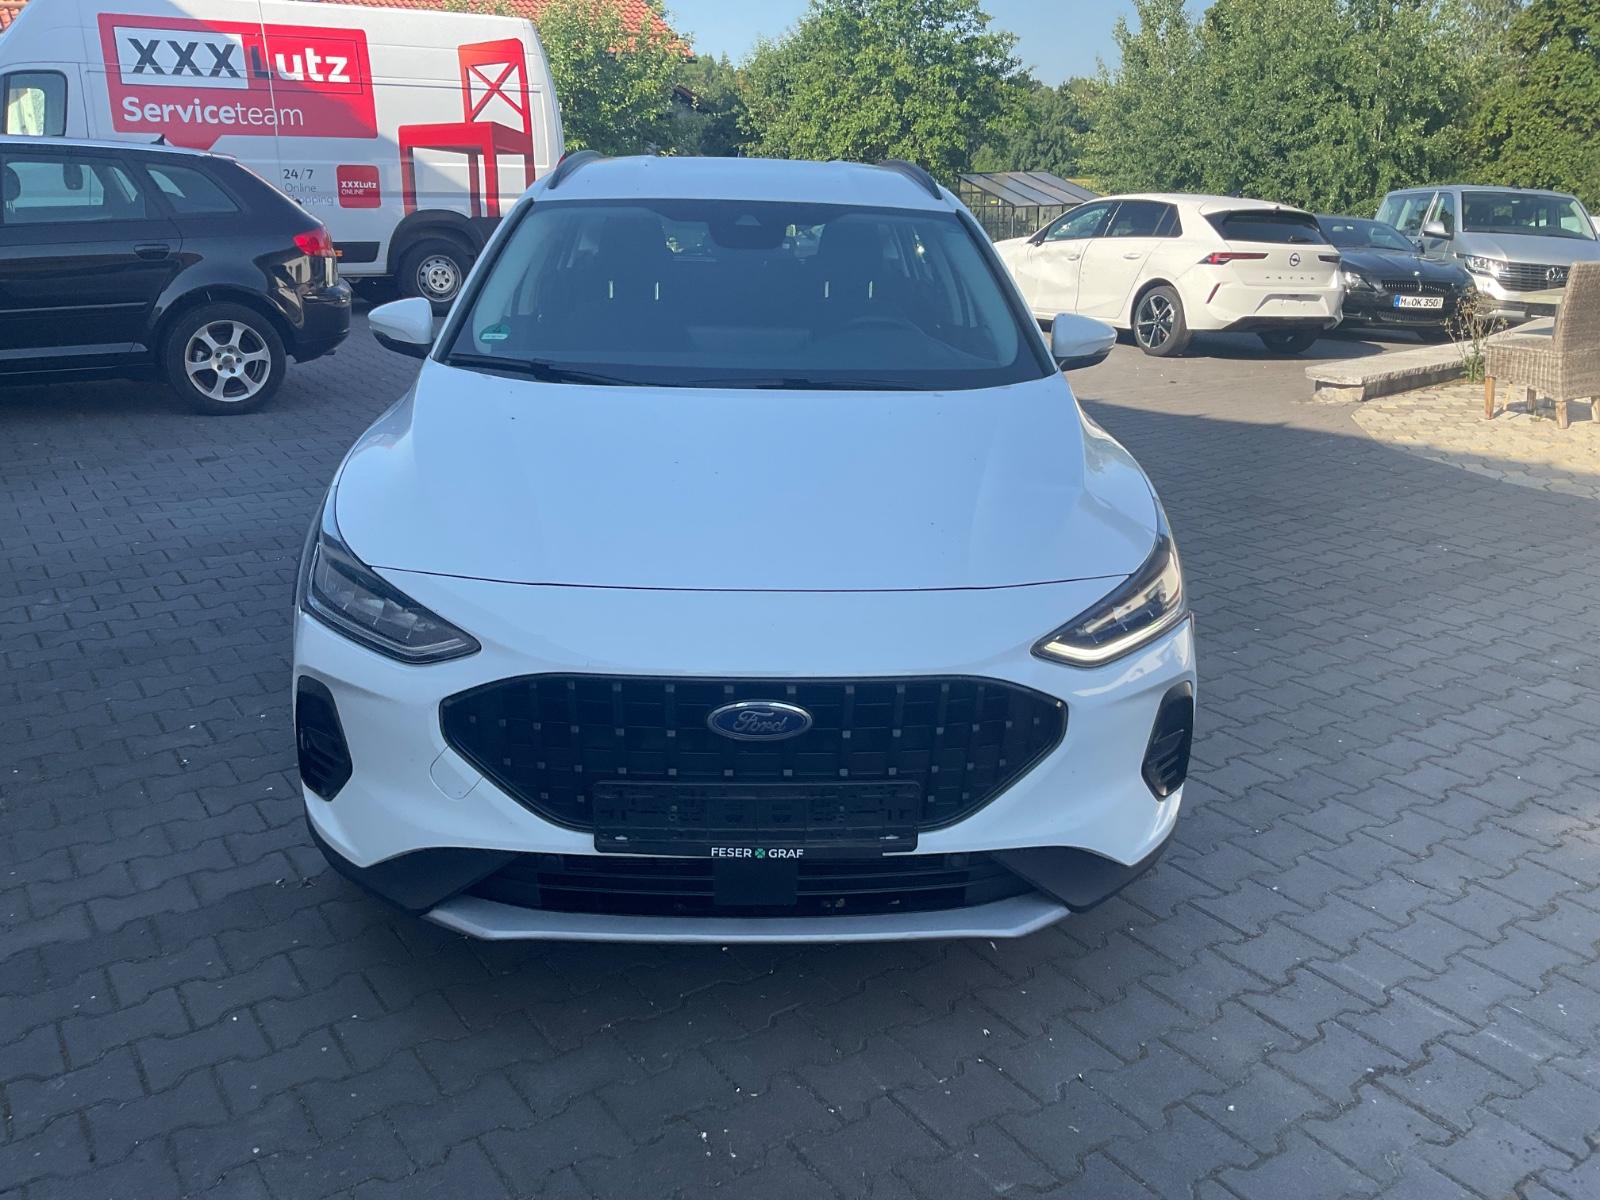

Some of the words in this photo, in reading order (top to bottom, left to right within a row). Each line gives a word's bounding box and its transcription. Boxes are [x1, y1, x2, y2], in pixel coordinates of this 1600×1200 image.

[121, 96, 304, 126] Serviceteam
[283, 168, 314, 180] 24/7
[284, 183, 317, 193] Online
[341, 180, 377, 189] XXXLutz
[733, 710, 788, 731] Ford
[711, 847, 752, 858] FESER
[768, 848, 804, 858] GRAF
